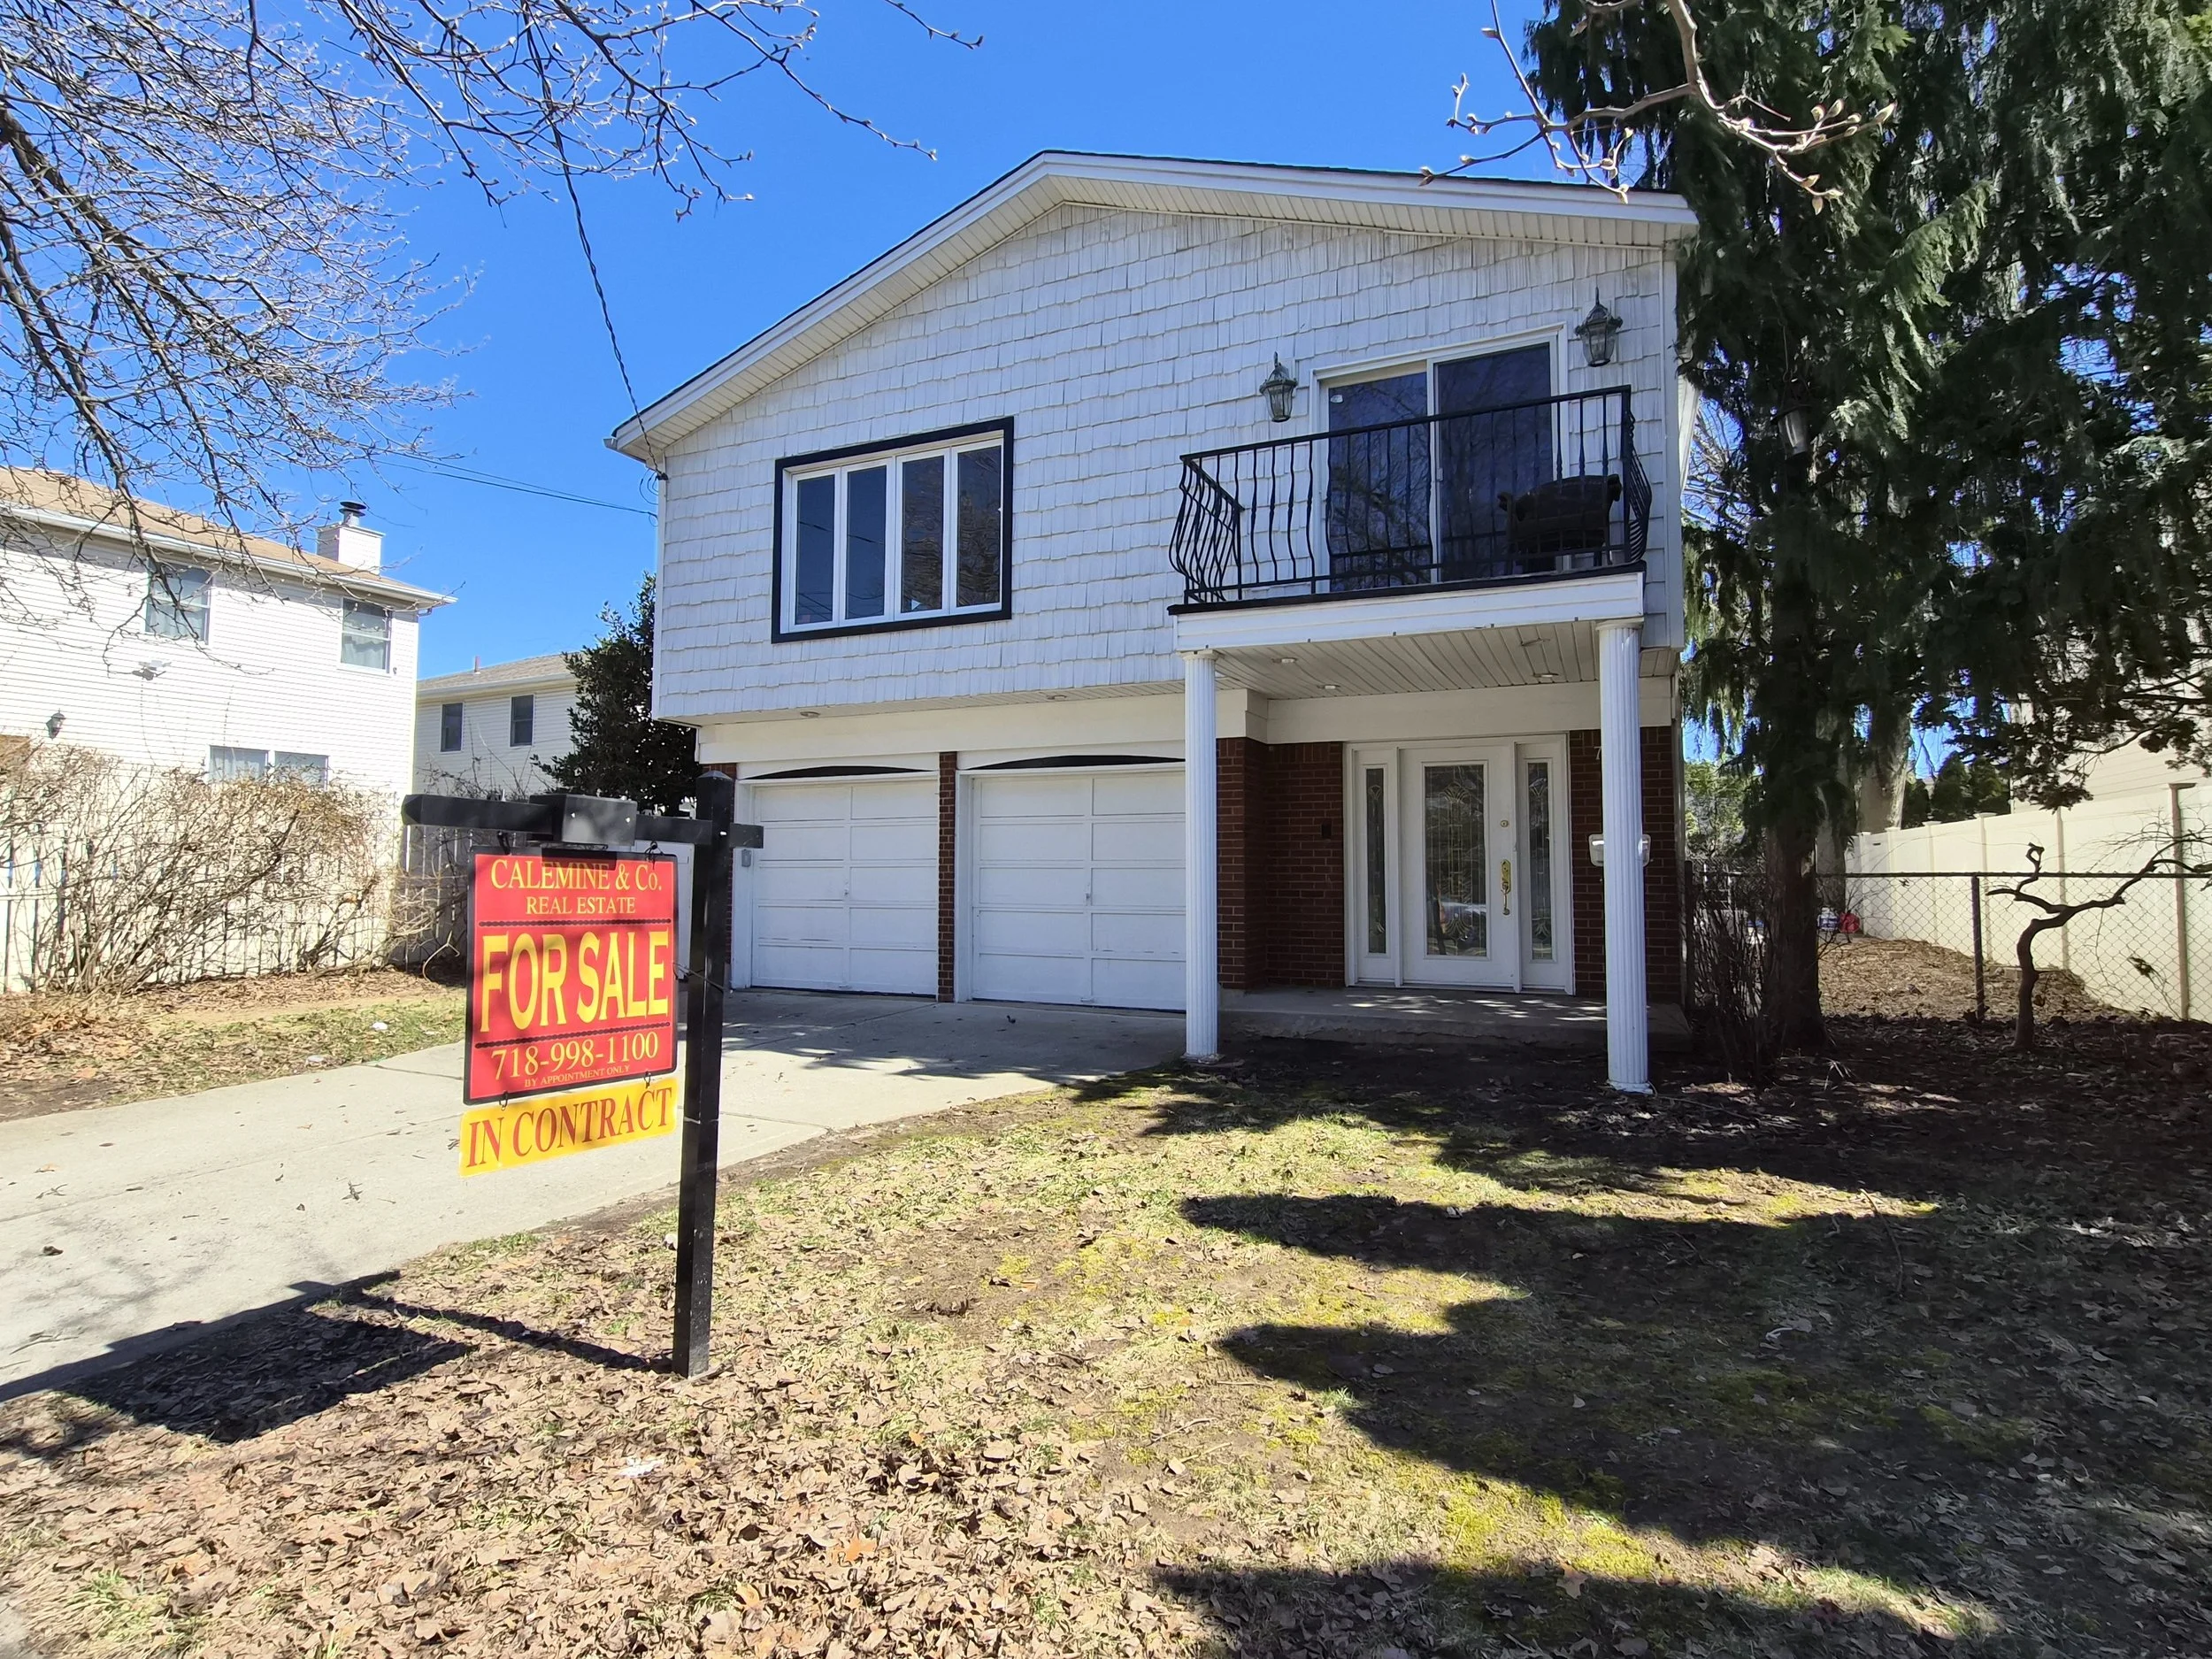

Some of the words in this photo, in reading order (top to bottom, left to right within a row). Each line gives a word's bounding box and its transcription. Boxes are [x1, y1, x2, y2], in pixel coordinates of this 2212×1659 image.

[491, 859, 611, 890] CALEMINE
[615, 864, 630, 890] &
[635, 864, 662, 891] Co.
[526, 896, 572, 914] REAL
[576, 896, 636, 914] ESTATE
[480, 933, 567, 1033] FOR
[576, 928, 669, 1023] SALE
[491, 1031, 658, 1080] 718-998-1100
[524, 1078, 538, 1087] BY
[541, 1071, 604, 1087] APPOINTMENT
[606, 1064, 630, 1075] ONLY
[465, 1117, 504, 1167] IN
[512, 1087, 672, 1157] CONTRACT
